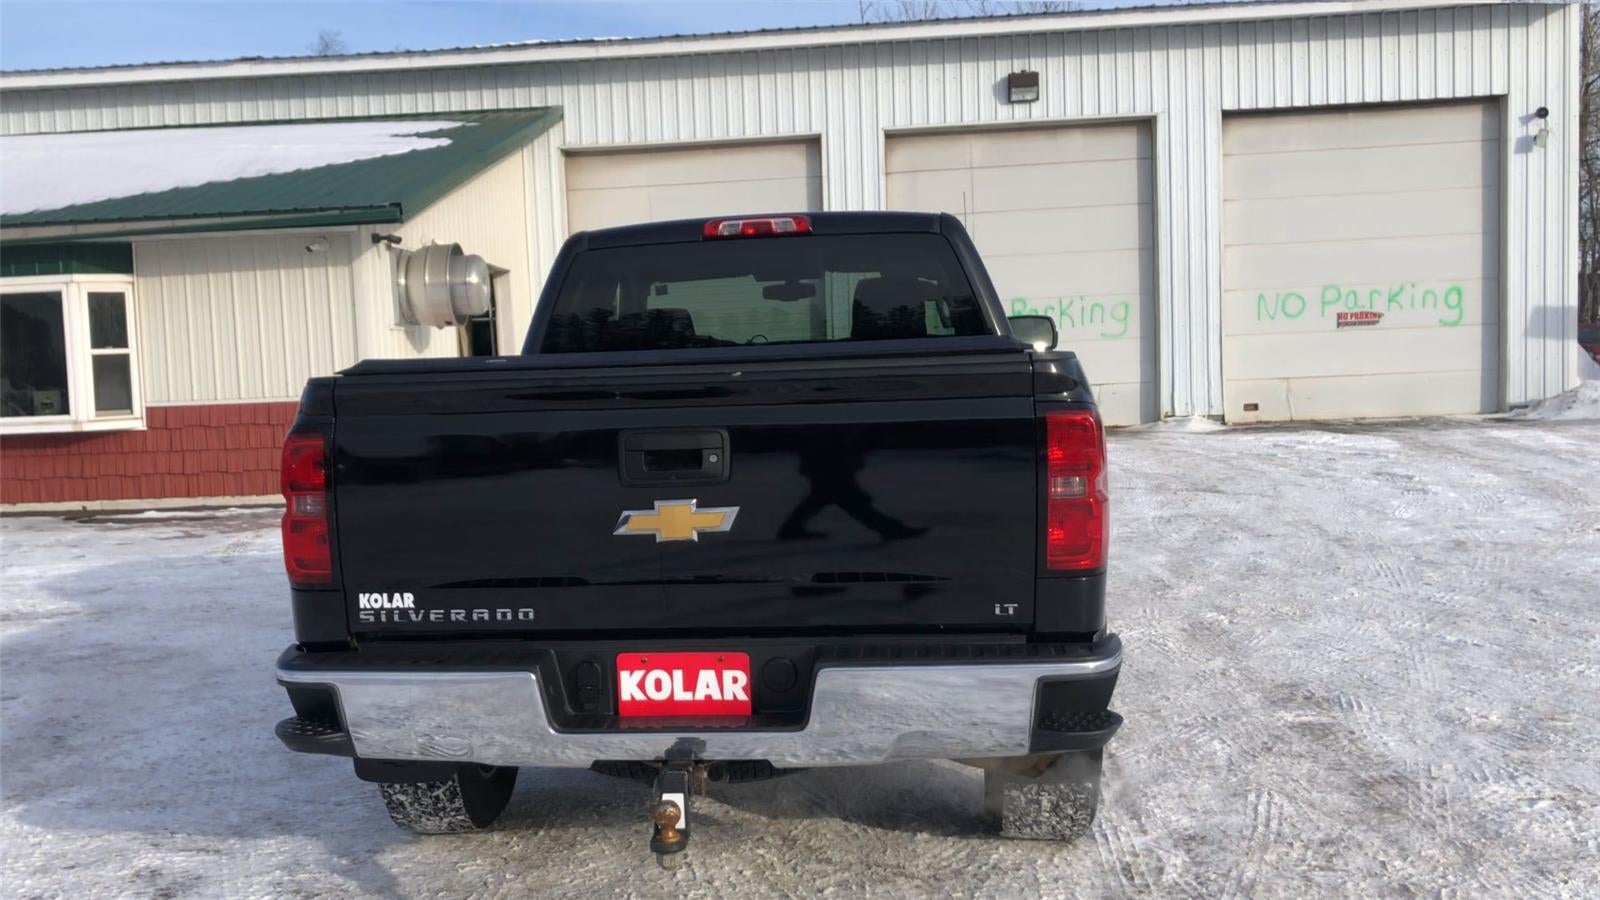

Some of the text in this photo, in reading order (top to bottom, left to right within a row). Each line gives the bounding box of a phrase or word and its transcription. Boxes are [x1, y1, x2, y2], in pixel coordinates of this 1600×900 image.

[1257, 291, 1306, 321] NO
[358, 592, 415, 608] KOLAR
[359, 607, 535, 622] SILVERADO
[994, 603, 1018, 615] LT
[619, 669, 749, 701] KOLAR
